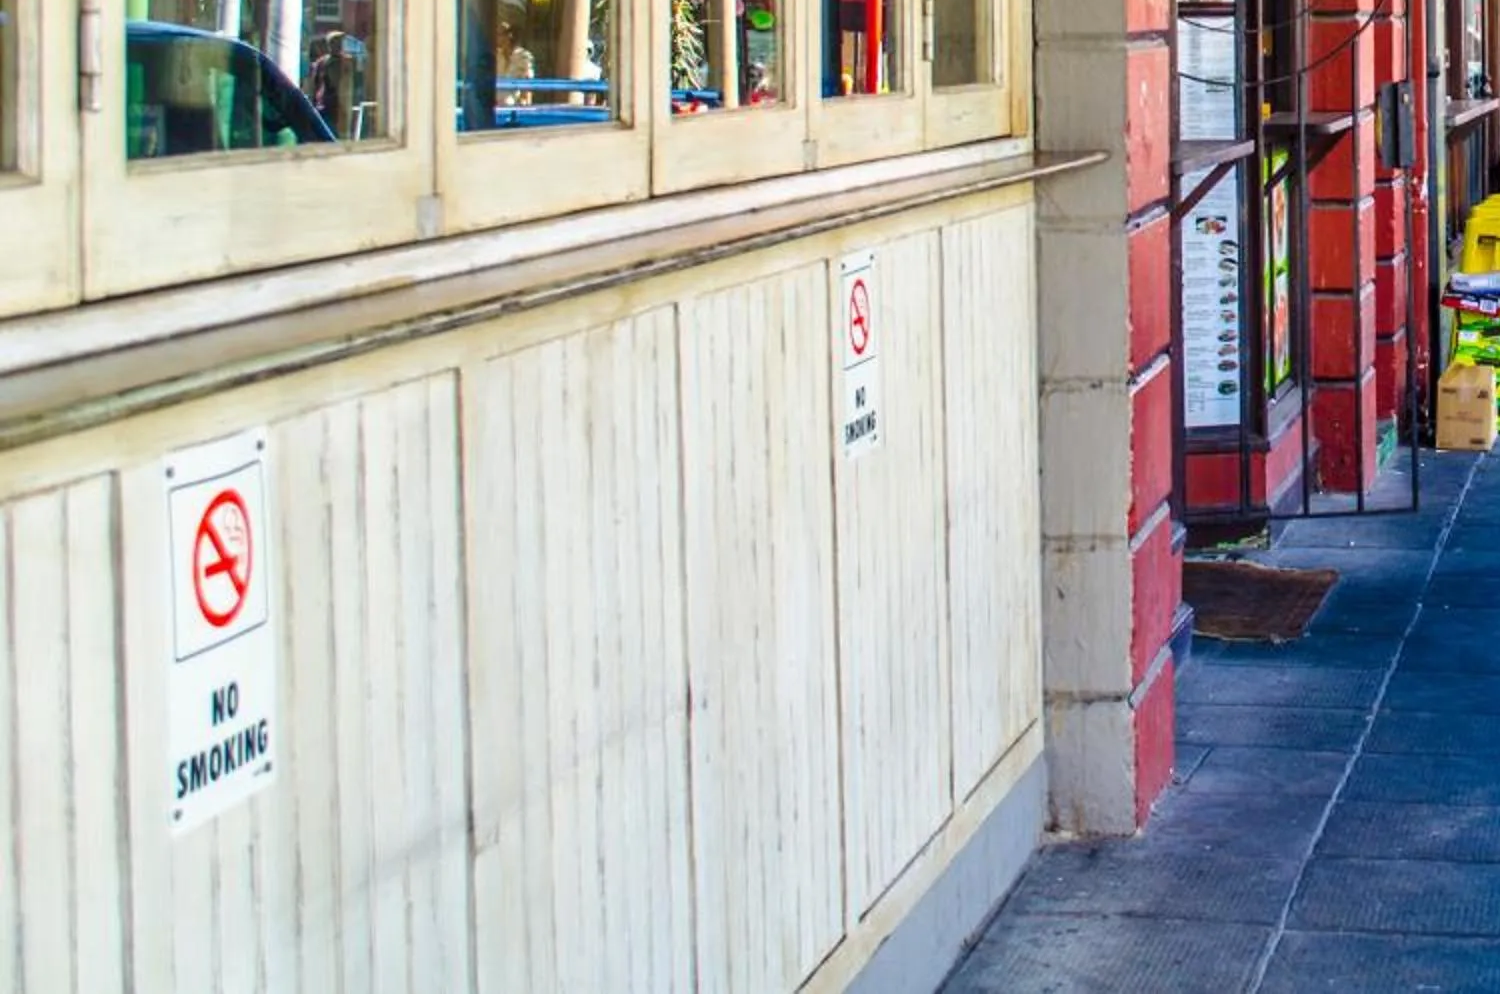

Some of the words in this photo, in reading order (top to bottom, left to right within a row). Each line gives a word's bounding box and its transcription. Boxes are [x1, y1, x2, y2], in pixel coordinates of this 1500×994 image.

[855, 385, 866, 409] NO
[845, 409, 877, 445] SMOKING
[212, 682, 239, 727] NO
[177, 718, 268, 799] SMOKING
